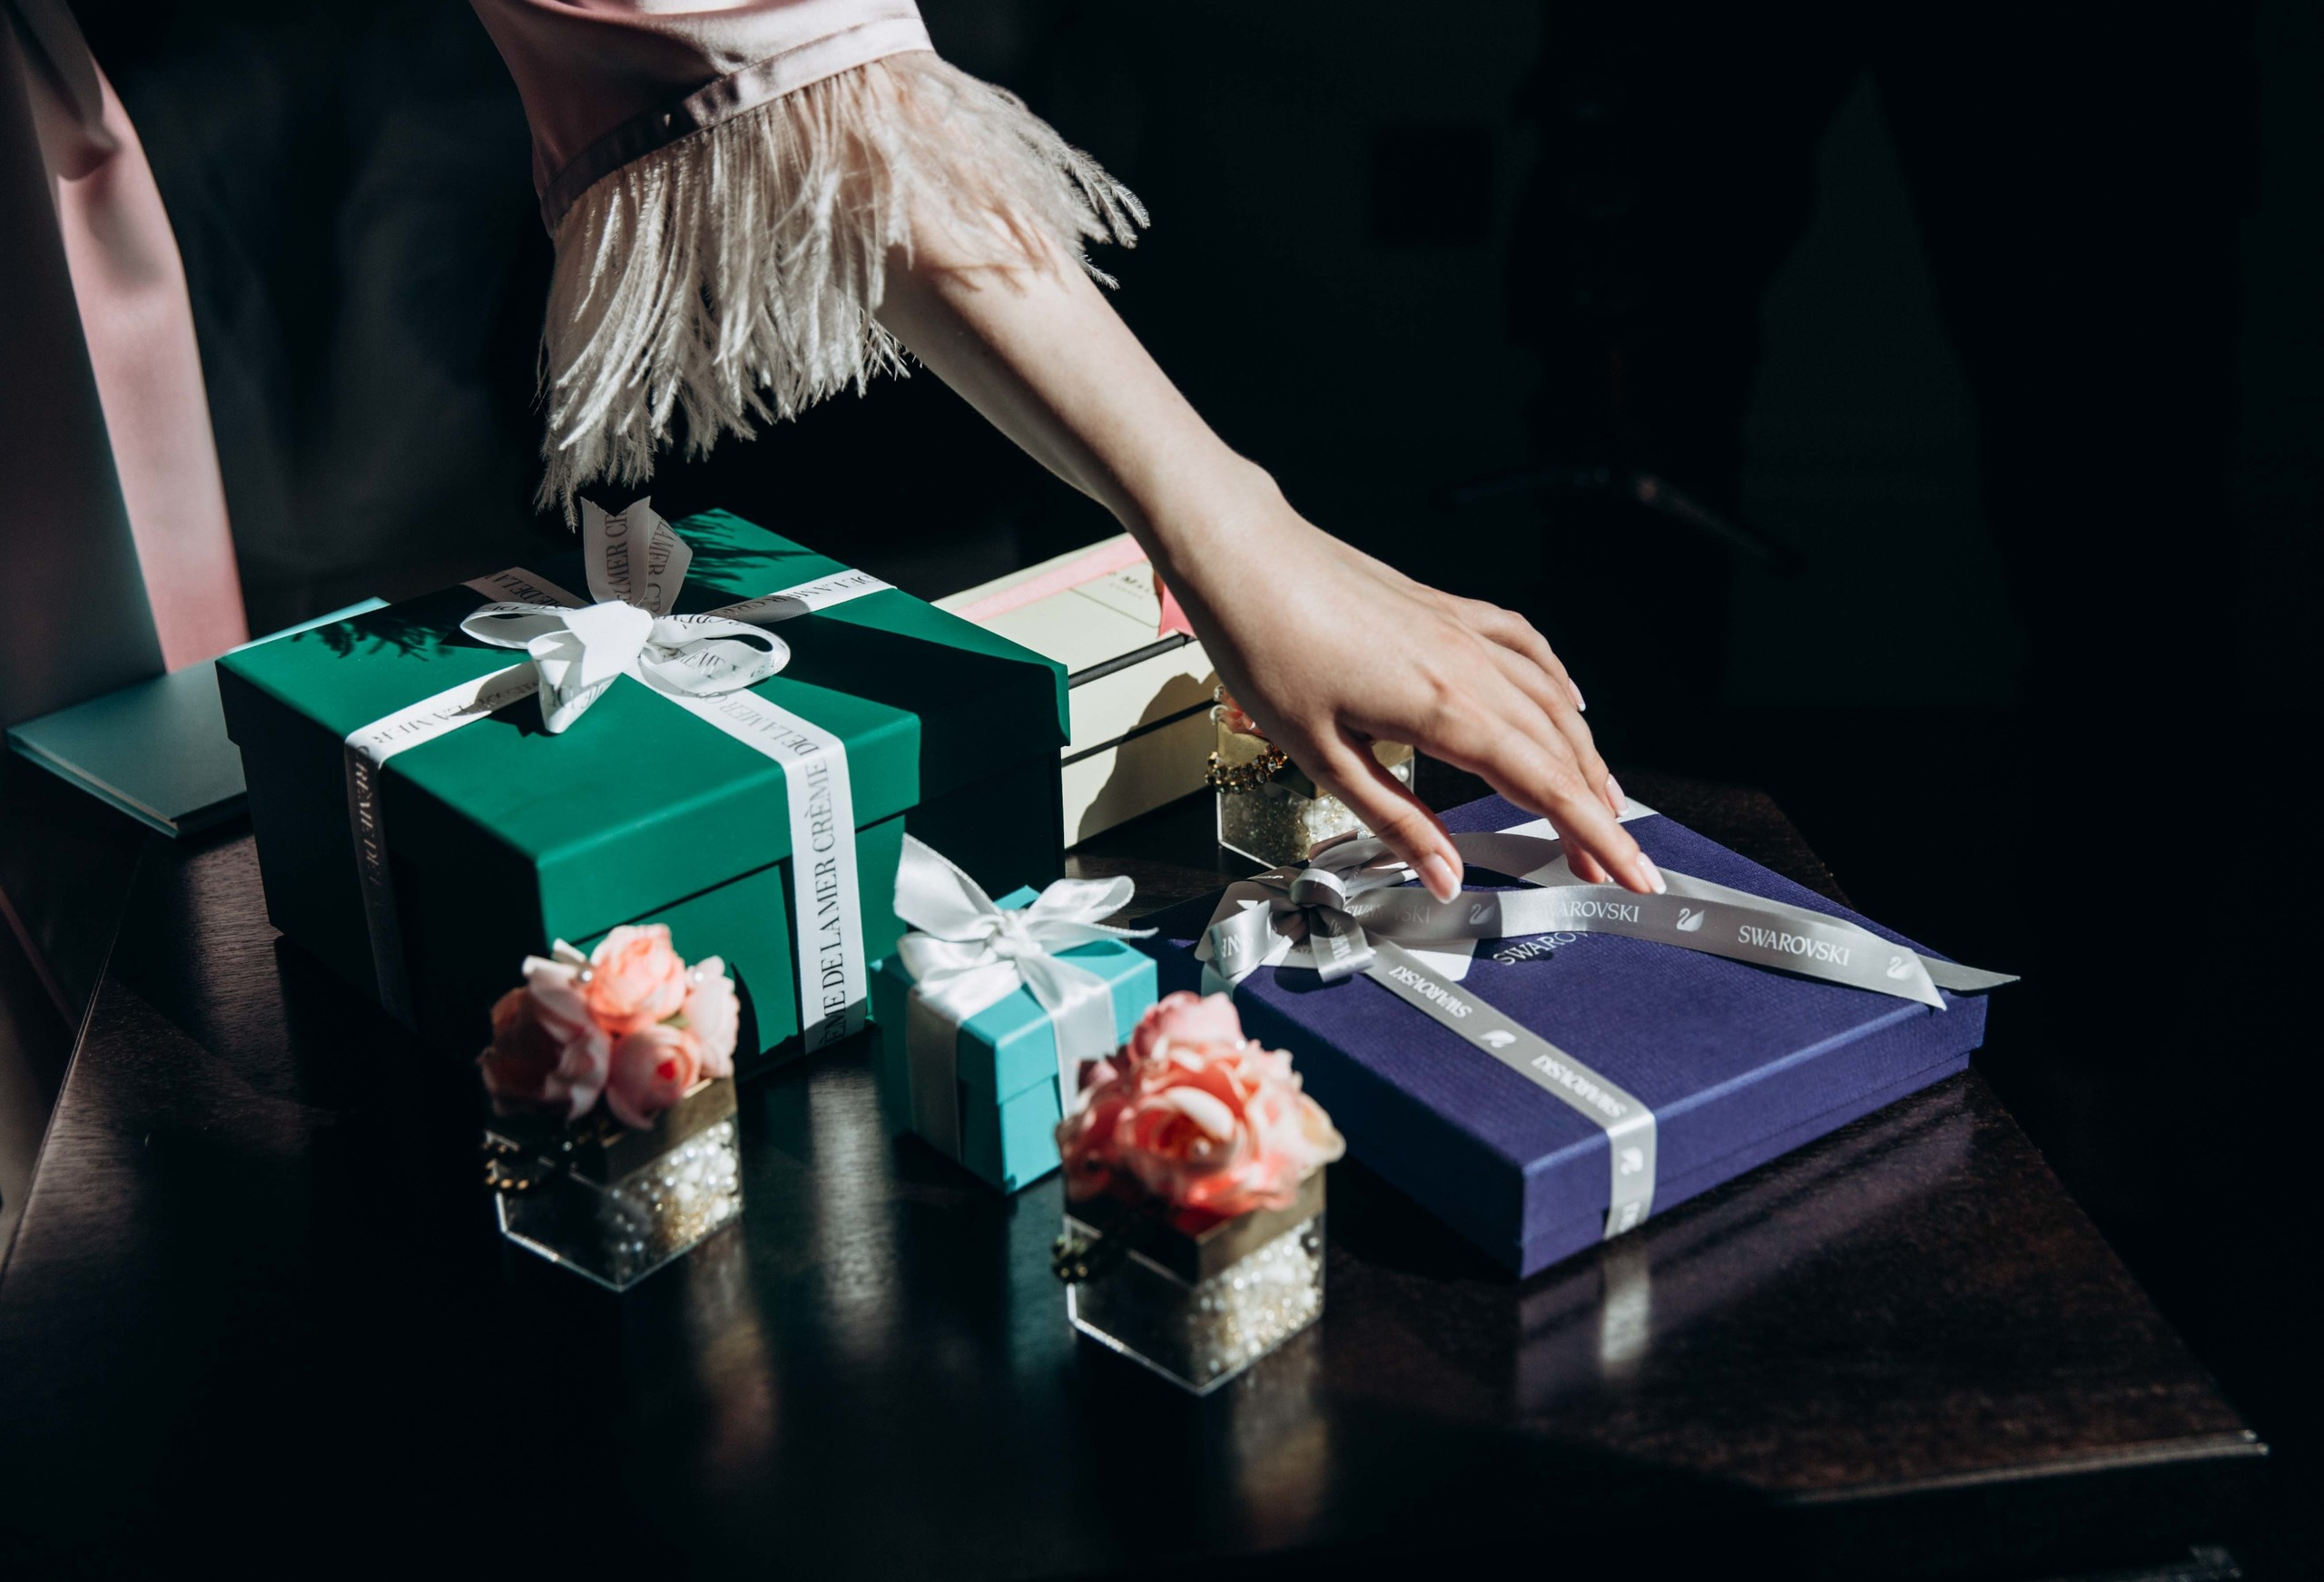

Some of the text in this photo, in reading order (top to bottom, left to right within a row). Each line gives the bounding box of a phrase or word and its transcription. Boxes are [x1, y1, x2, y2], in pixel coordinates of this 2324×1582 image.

[606, 542, 630, 585] MER
[804, 759, 835, 853] CRÈME
[814, 856, 840, 916] MER
[819, 916, 842, 955] LA
[1493, 931, 1588, 966] SWARO
[1738, 925, 1851, 966] SWAROVSKI
[820, 952, 845, 991] DE
[1388, 965, 1472, 1018] SWAROVSKI
[1531, 1054, 1628, 1117] SWAROVSKI
